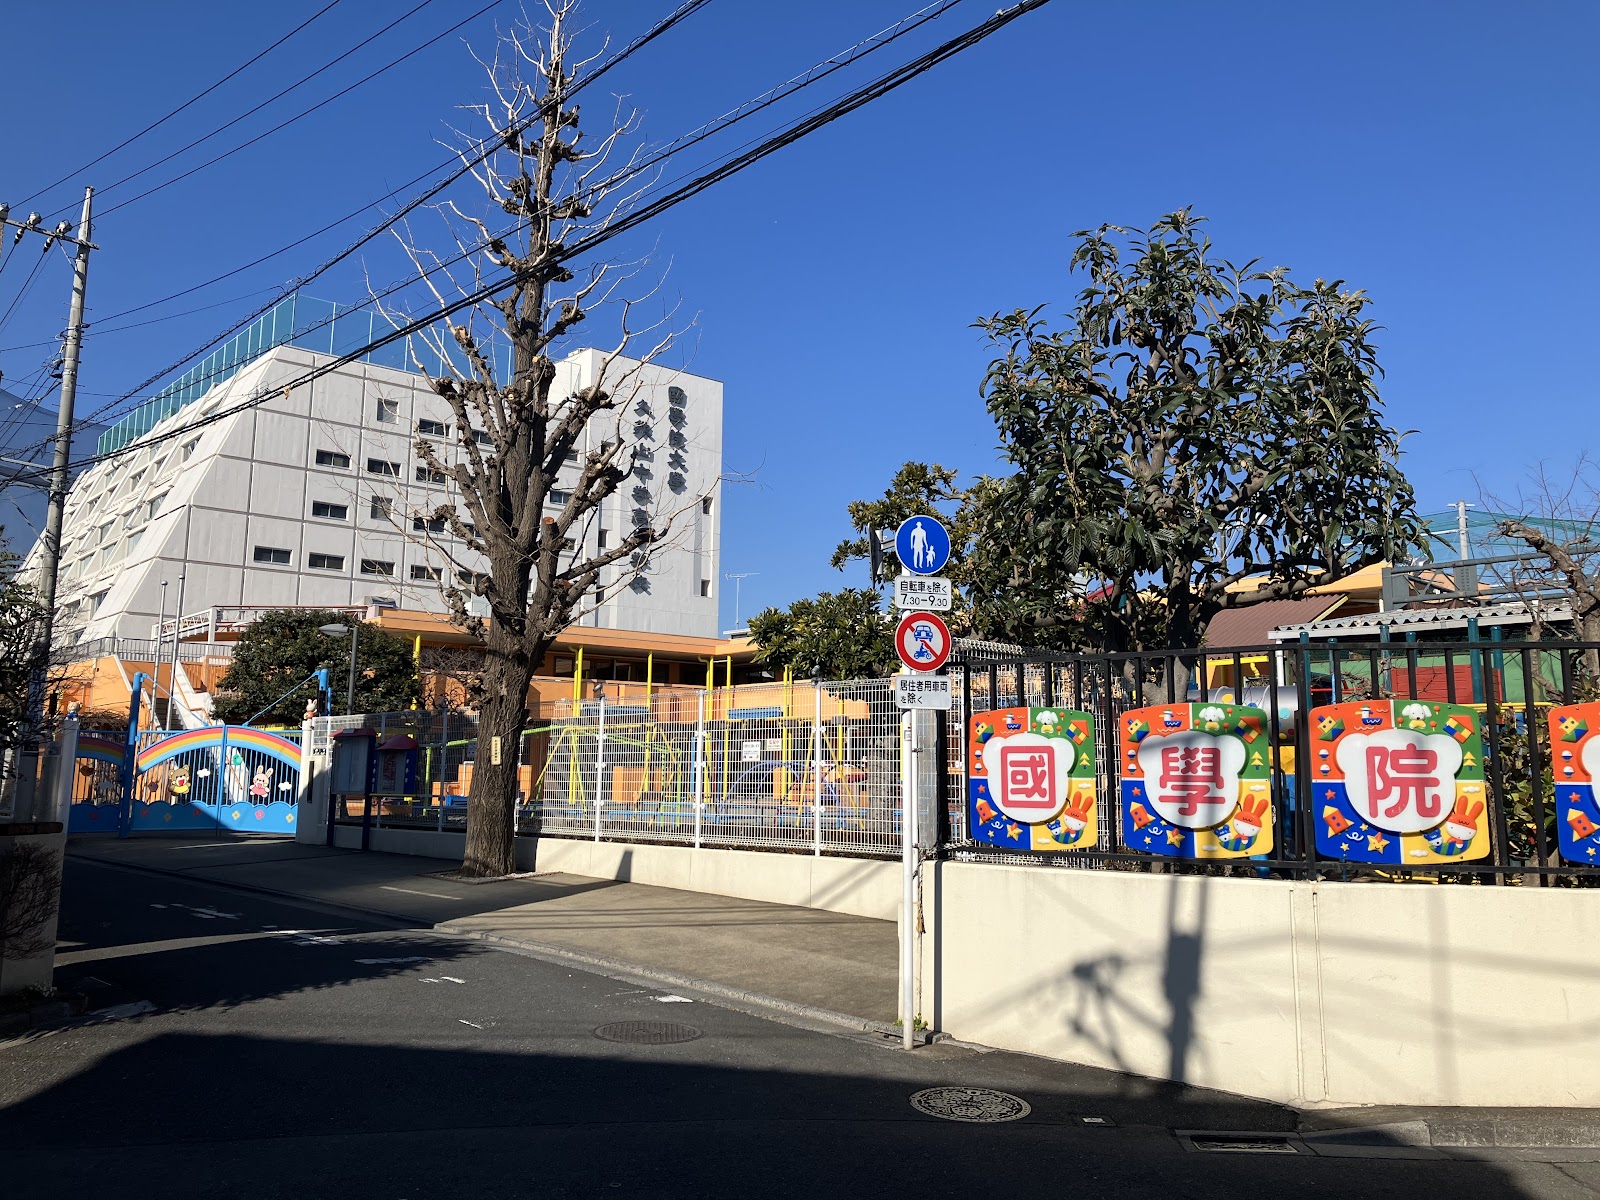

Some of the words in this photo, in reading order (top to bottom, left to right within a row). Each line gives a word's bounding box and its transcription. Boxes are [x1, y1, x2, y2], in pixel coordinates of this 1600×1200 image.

[900, 580, 947, 593] 自転車を除く
[900, 680, 948, 693] 居住者用車両
[900, 693, 923, 705] を除く
[1000, 745, 1056, 809] 國
[1158, 746, 1226, 816] 學
[1366, 743, 1441, 818] 院
